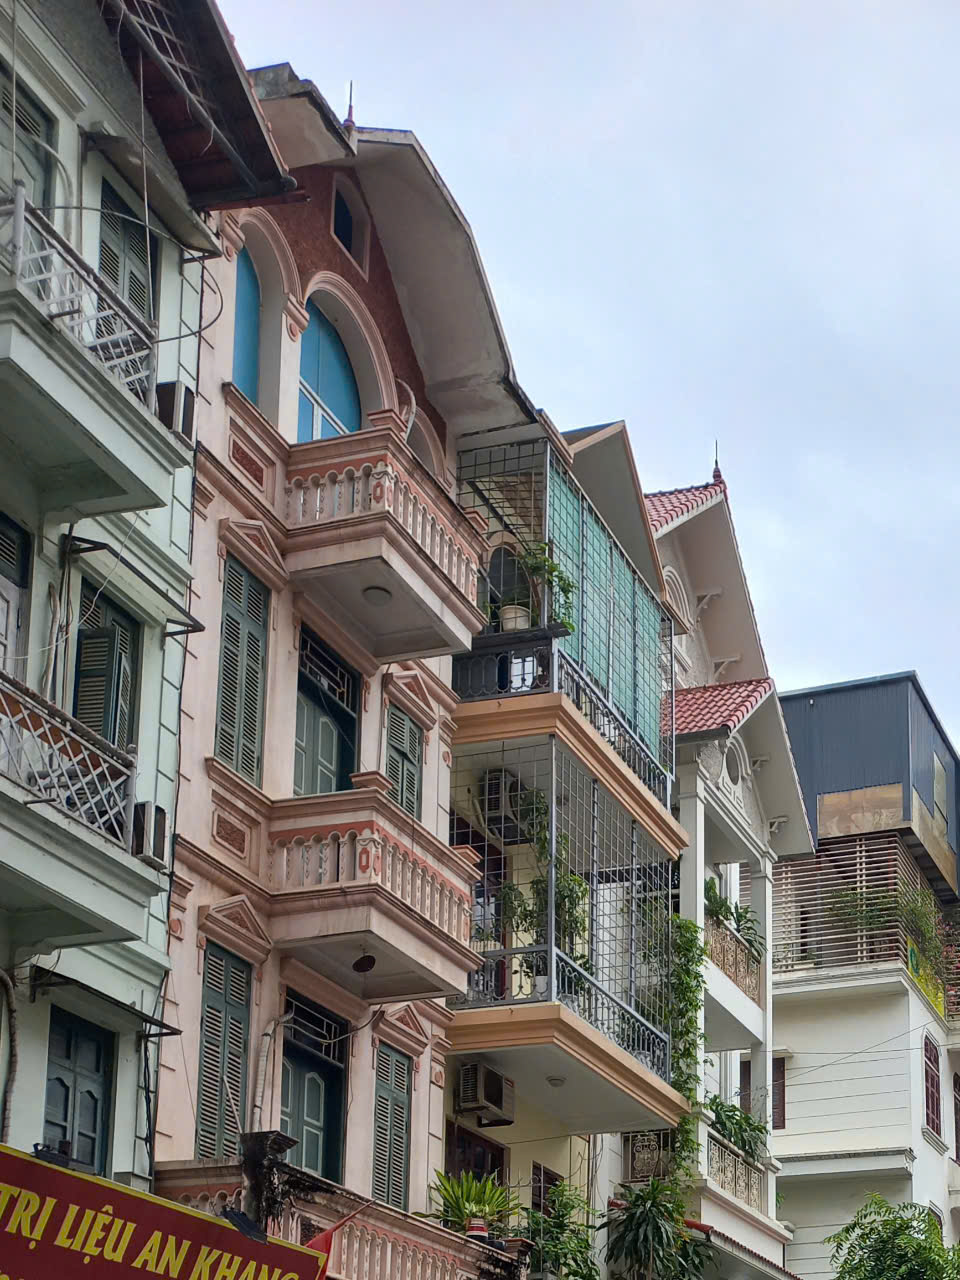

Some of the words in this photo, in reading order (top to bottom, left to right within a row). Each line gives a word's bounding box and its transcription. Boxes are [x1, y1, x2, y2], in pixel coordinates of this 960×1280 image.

[0, 1182, 57, 1250] TRỊ
[54, 1205, 137, 1264] LIỆU
[131, 1230, 192, 1279] AN
